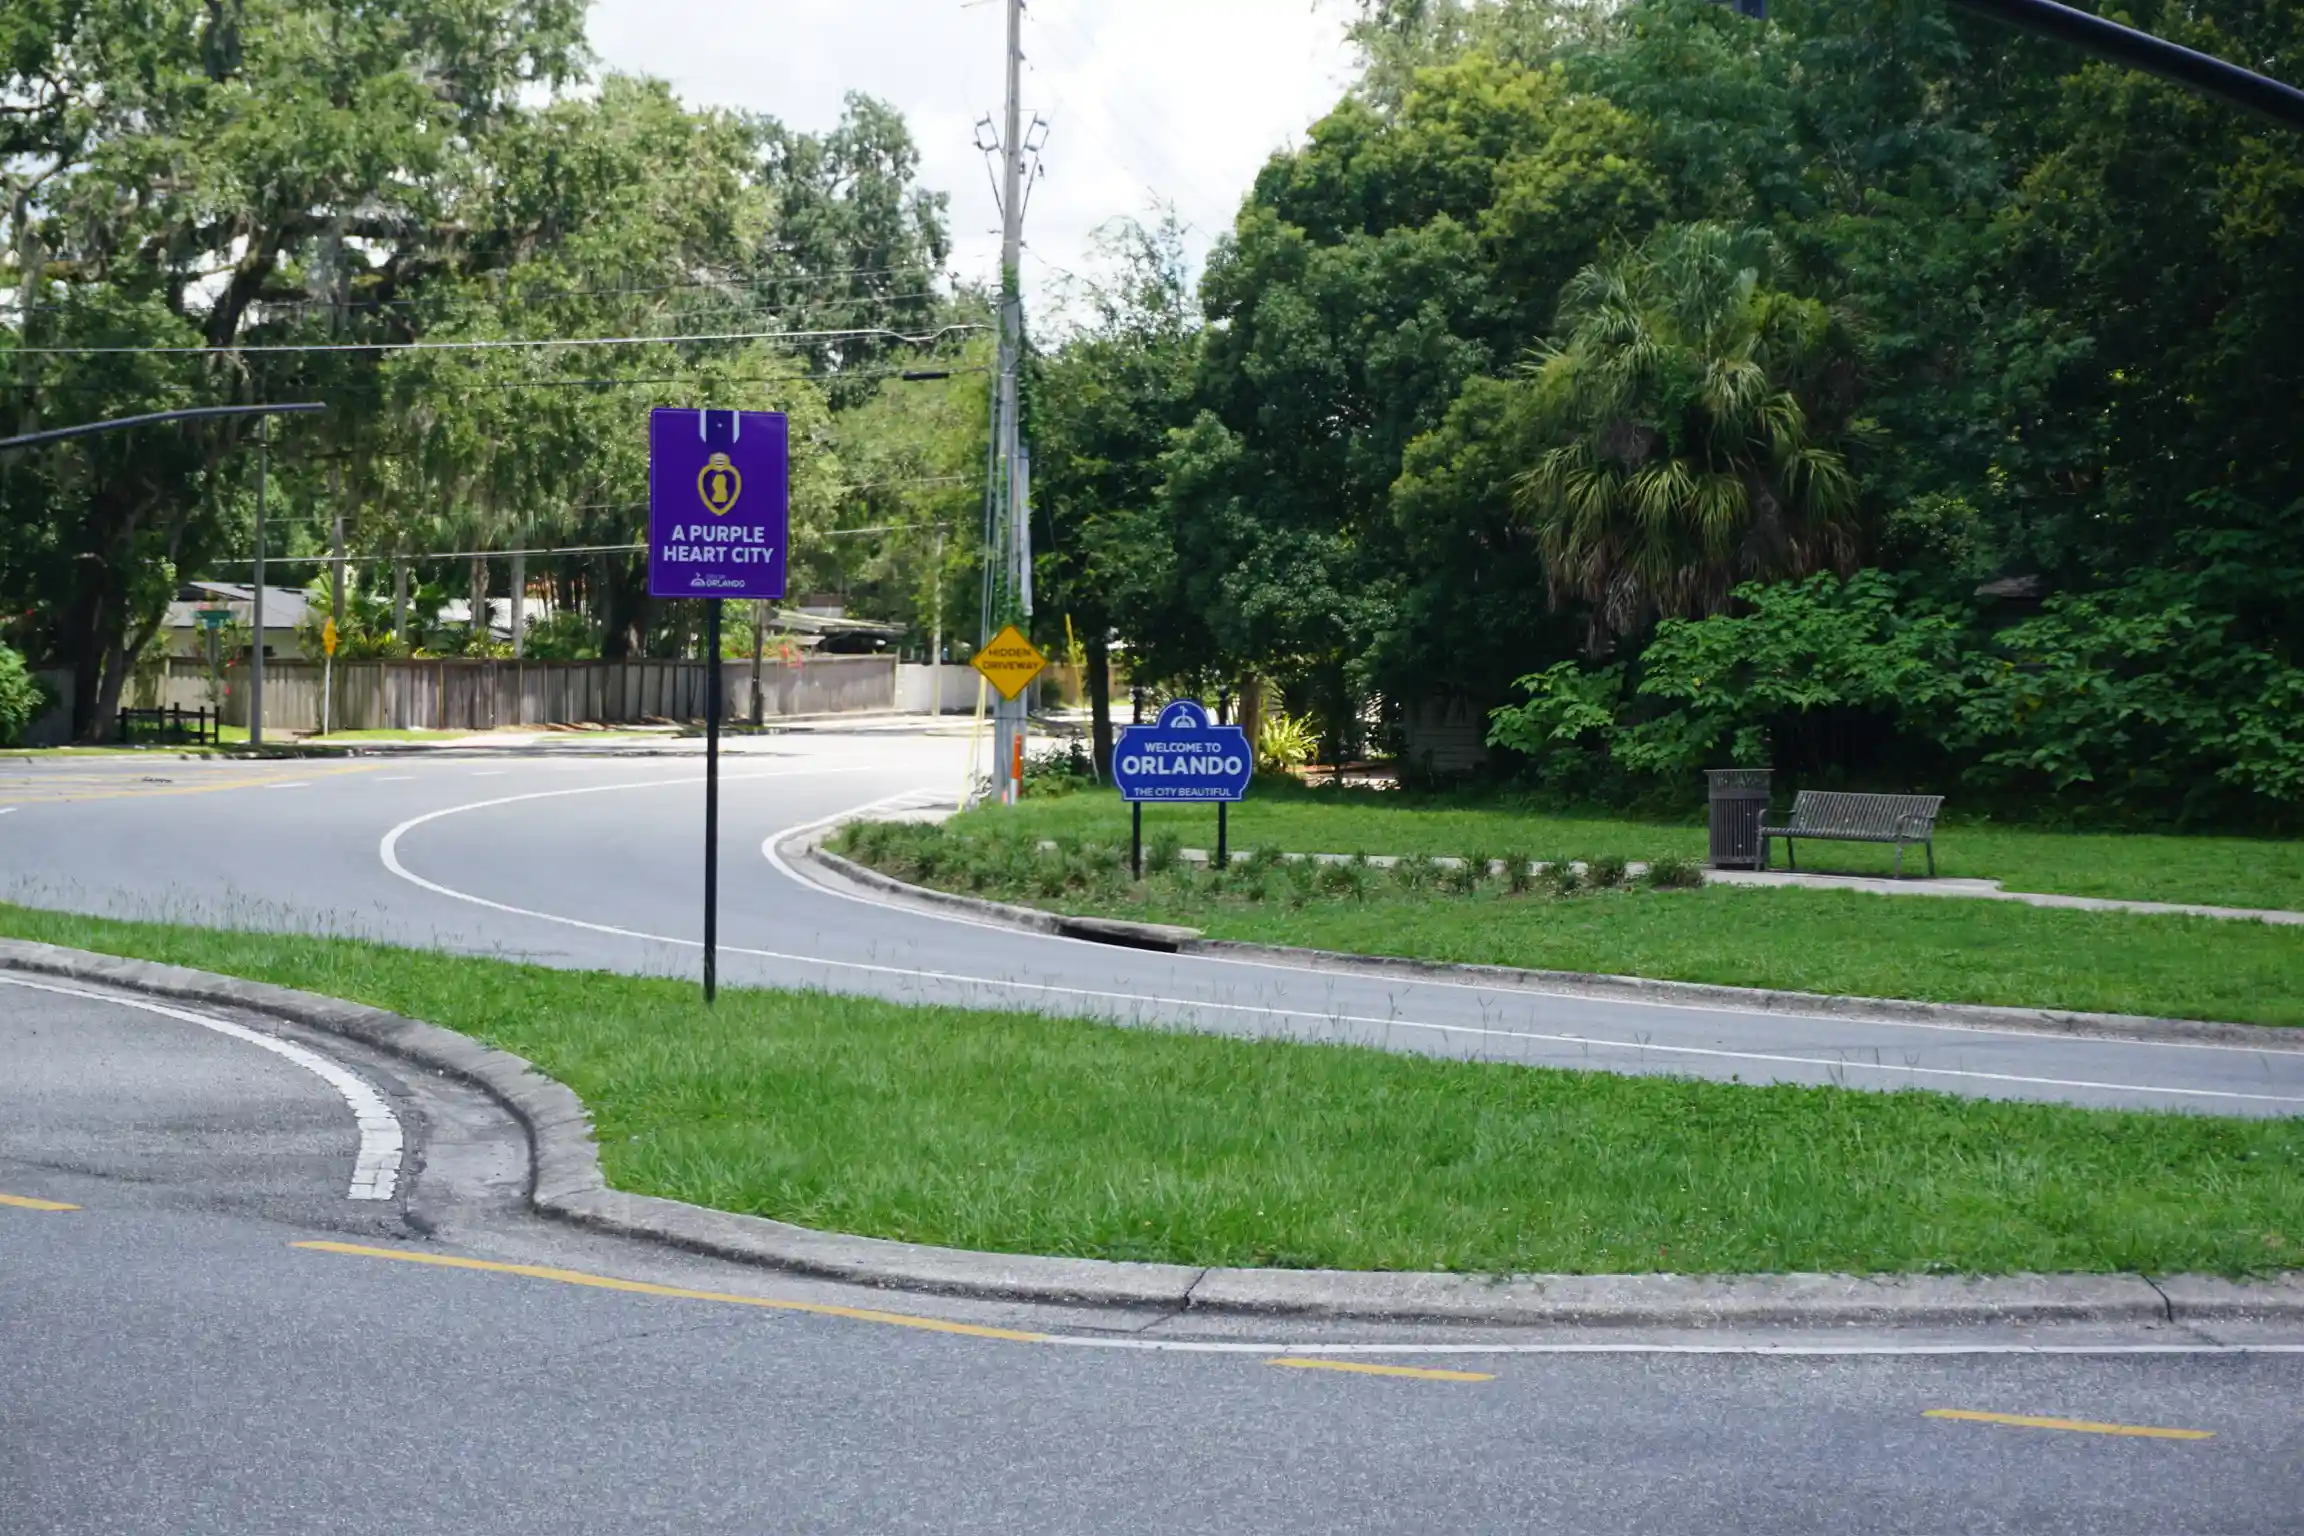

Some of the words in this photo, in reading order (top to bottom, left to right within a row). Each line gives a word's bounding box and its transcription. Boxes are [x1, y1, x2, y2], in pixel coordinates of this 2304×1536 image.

[671, 524, 686, 541] A
[689, 525, 765, 543] PURPLE
[663, 545, 727, 562] HEART
[731, 547, 774, 563] CITY
[706, 579, 745, 588] ORLANDO
[988, 648, 1032, 657] HIDDEN
[983, 661, 1038, 670] DRIVEWAY
[1144, 742, 1202, 753] WELCOME
[1205, 742, 1222, 753] TO
[1121, 755, 1243, 775] ORLANDO
[1134, 787, 1154, 797] THE
[1155, 787, 1177, 797] CITY
[1178, 787, 1232, 797] BEAUTIFUL
